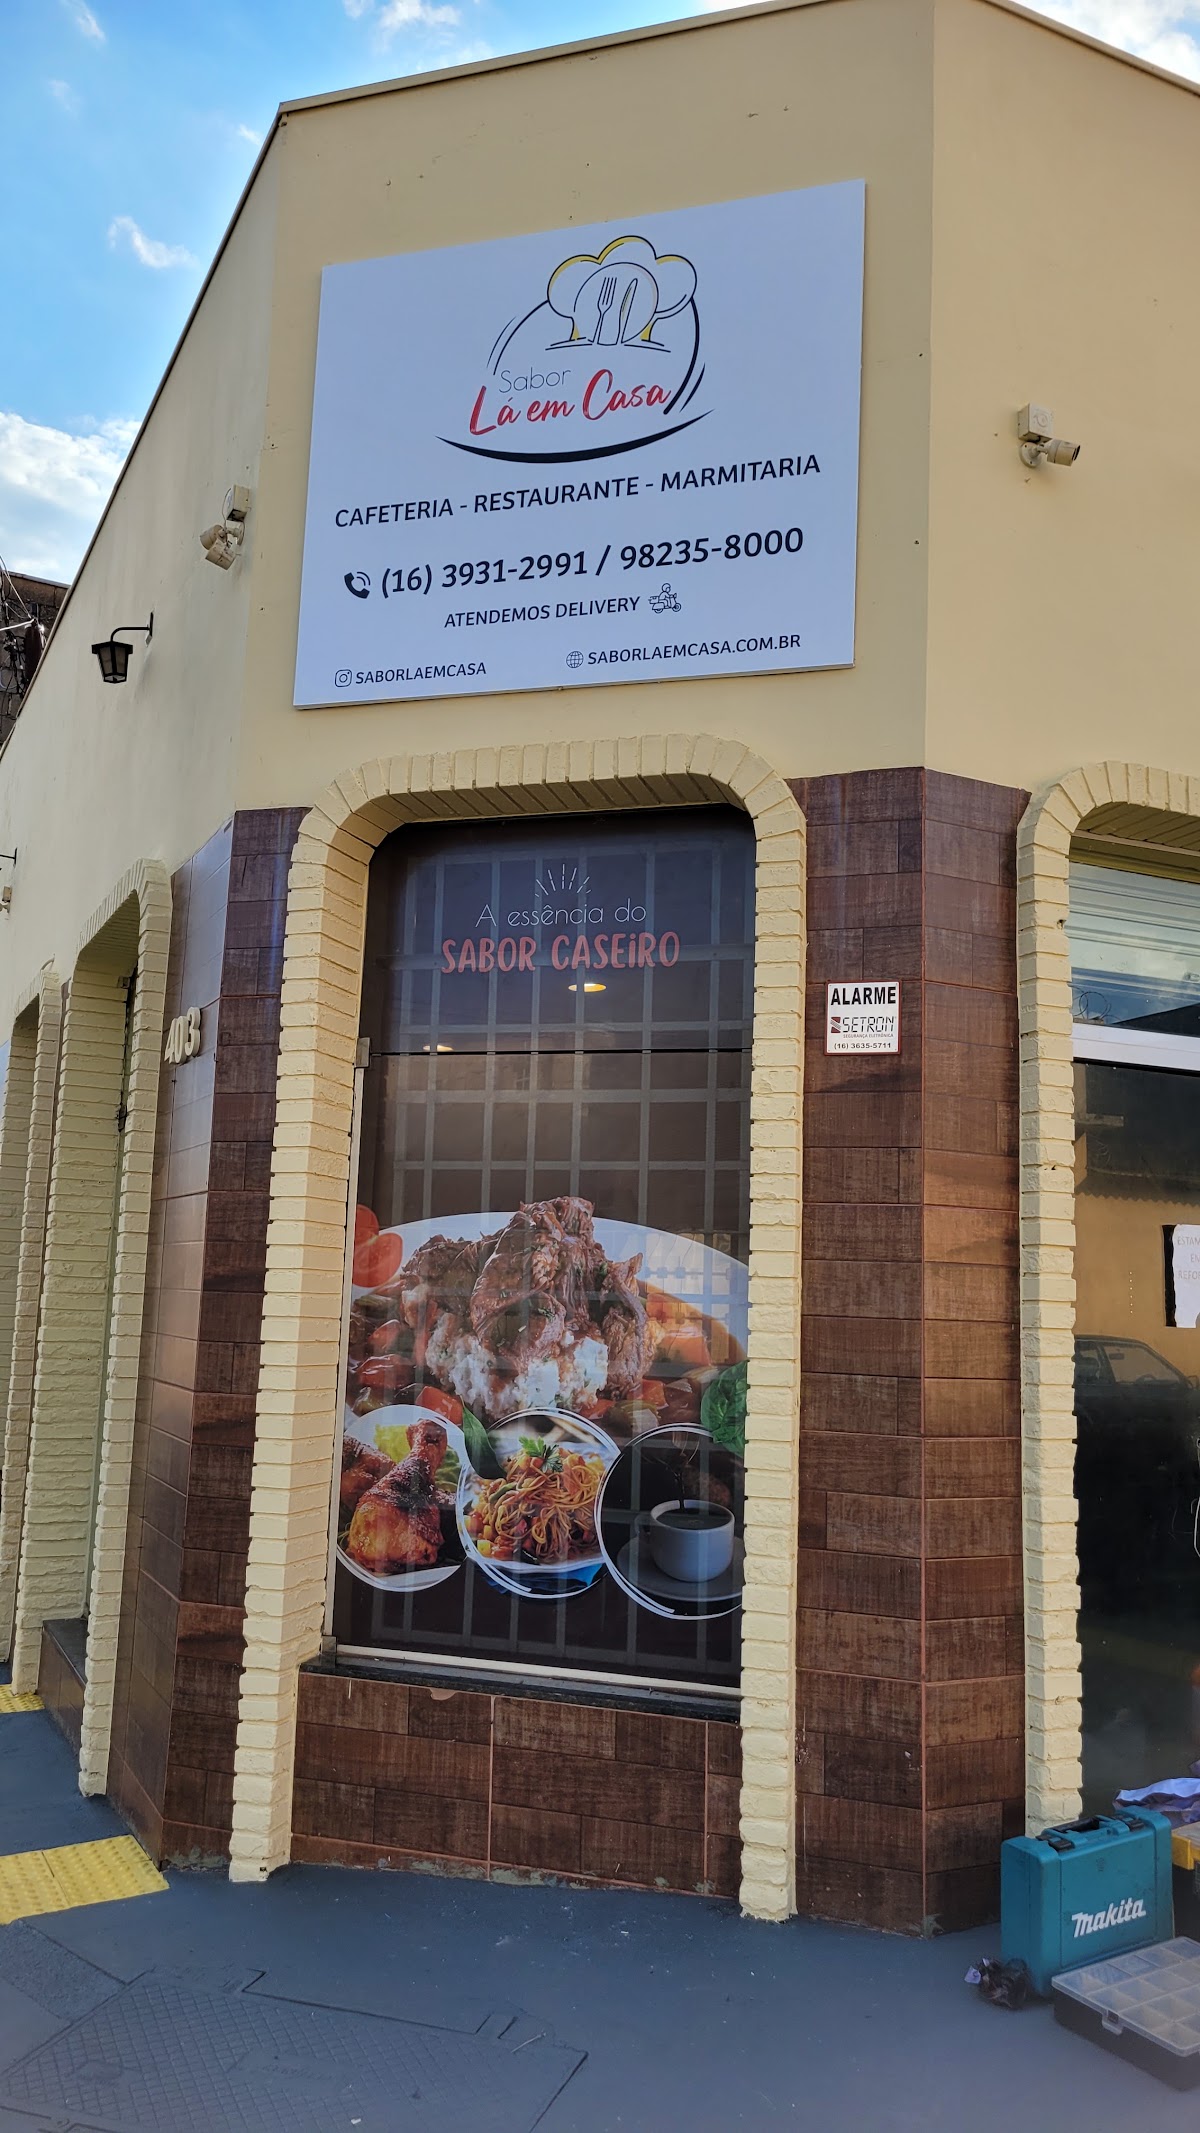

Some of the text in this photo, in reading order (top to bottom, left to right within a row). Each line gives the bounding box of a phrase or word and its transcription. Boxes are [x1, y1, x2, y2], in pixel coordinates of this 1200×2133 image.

[499, 366, 571, 393] Sabor
[469, 368, 672, 436] Lá em Casa
[335, 498, 454, 528] CAFETERIA
[474, 476, 639, 513] RESTAURANTE
[660, 454, 821, 492] MARMITARIA
[381, 564, 432, 599] (16)
[441, 550, 588, 588] 3931-2991
[620, 527, 804, 570] 98235-8000
[444, 596, 641, 628] ATENDEMOS DELIVERY
[588, 634, 801, 665] SABORLAEMCASA.COM.BR
[355, 662, 487, 684] SABORLAEMCASA
[475, 898, 647, 927] A essência do
[441, 936, 537, 974] SABOR
[830, 986, 896, 1005] ALARME
[164, 1006, 201, 1065] 403
